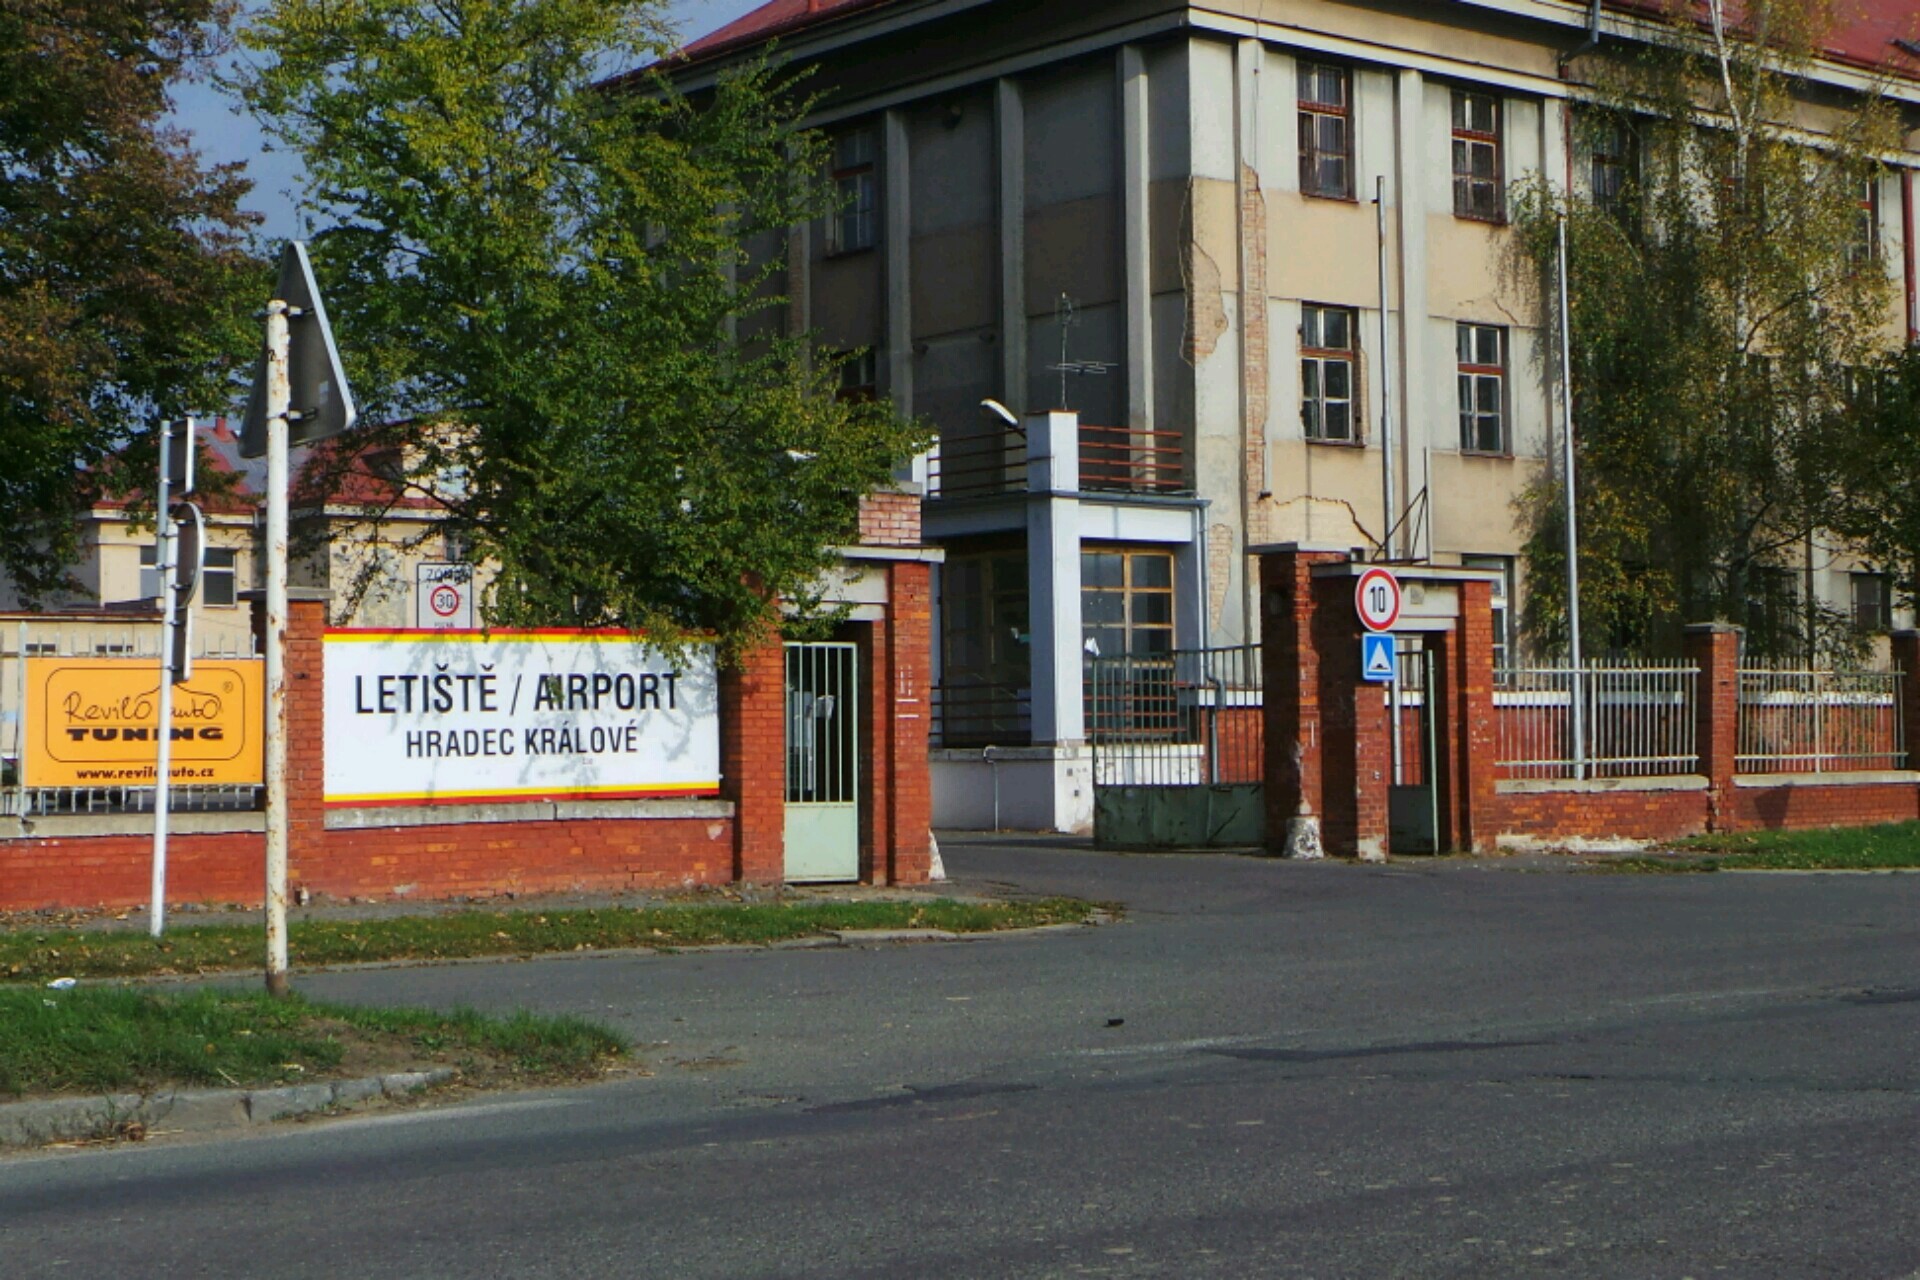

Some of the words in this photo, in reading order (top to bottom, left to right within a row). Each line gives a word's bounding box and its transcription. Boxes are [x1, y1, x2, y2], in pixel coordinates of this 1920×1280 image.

[436, 593, 454, 609] 30
[1370, 586, 1386, 613] 10
[355, 663, 498, 714] LETIŠTĚ
[510, 673, 522, 716] /
[534, 672, 682, 711] AIRPORT
[406, 728, 514, 758] HRADEC
[525, 719, 639, 755] KRÁLOVÉ
[76, 766, 214, 779] www.reviluto.cz
